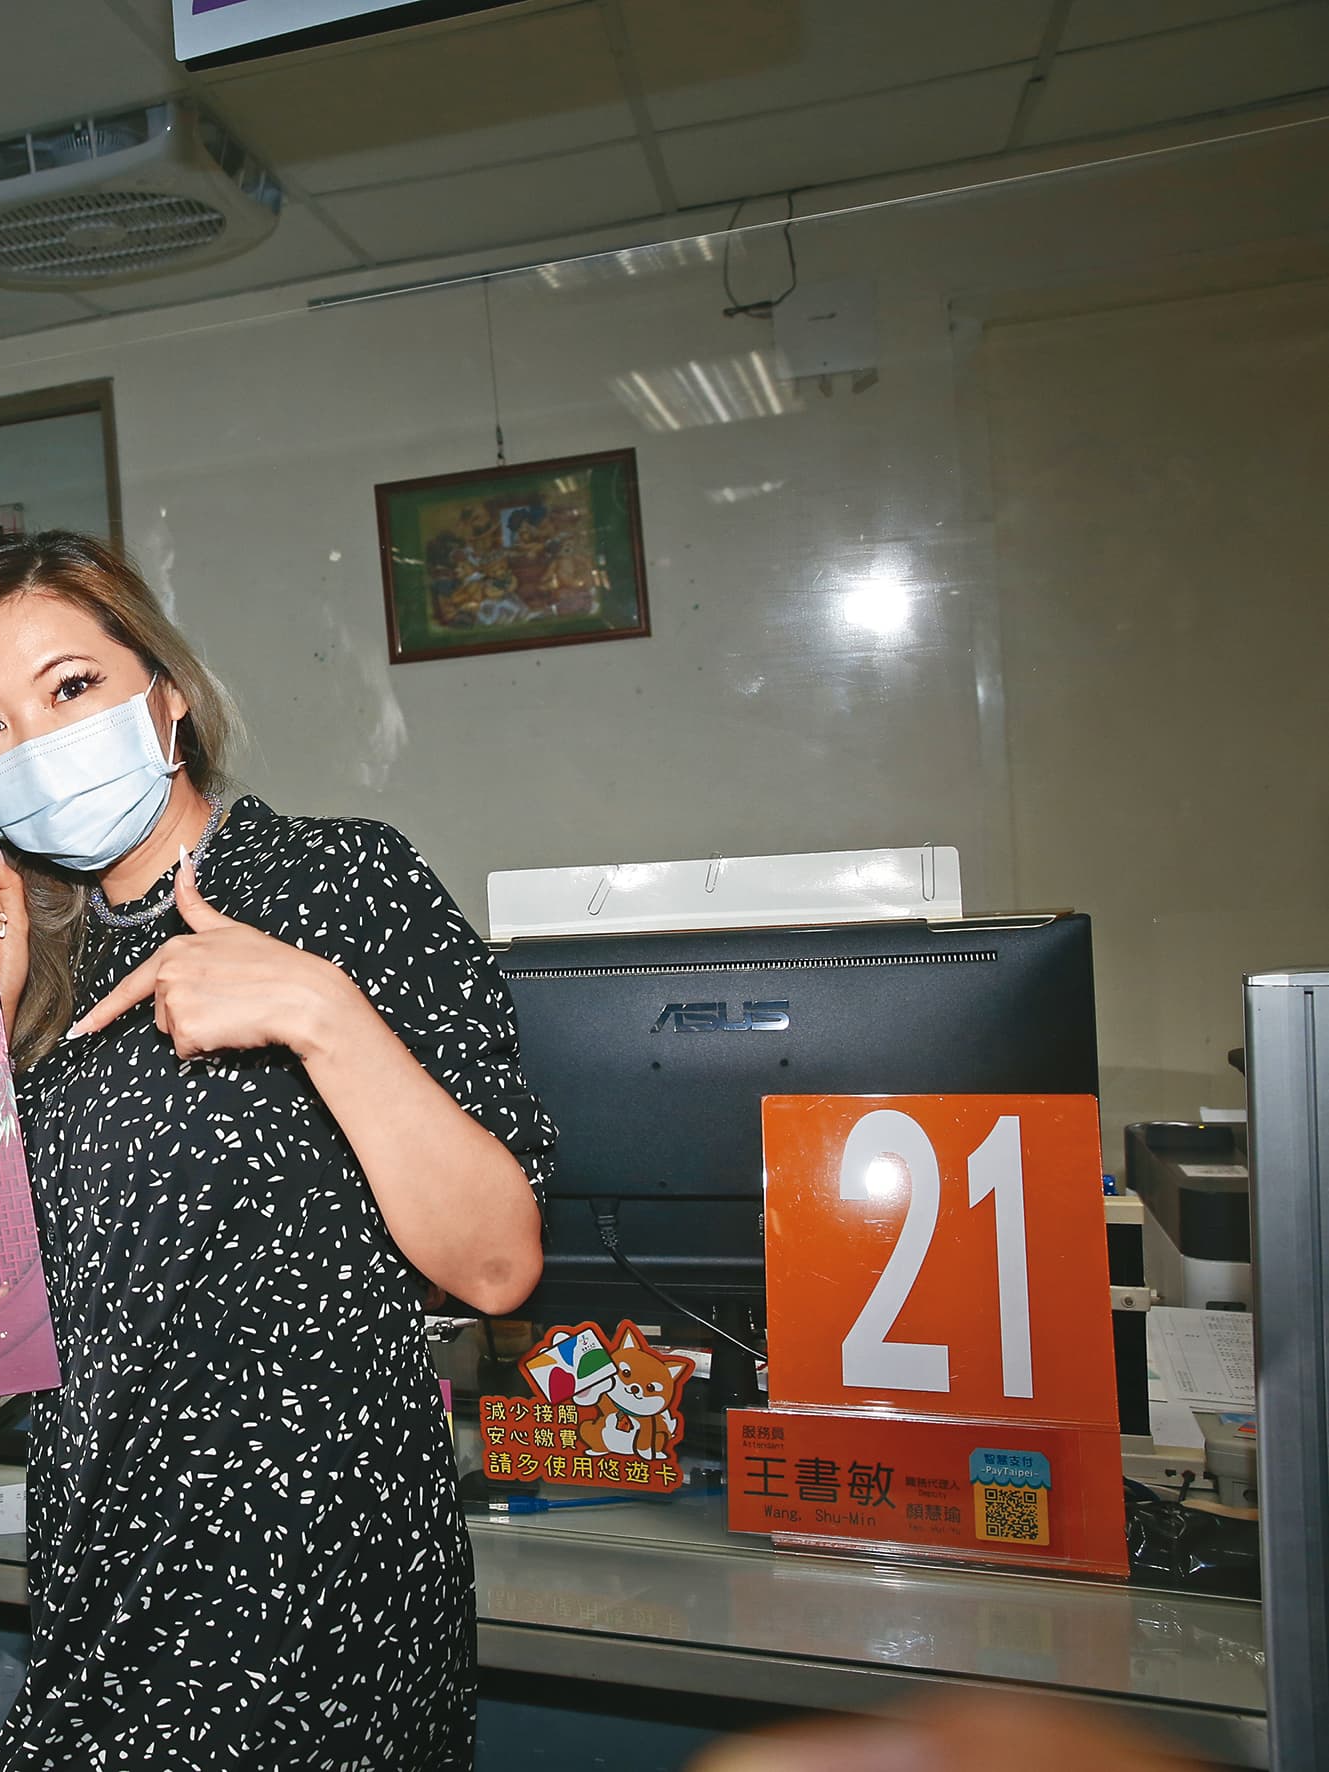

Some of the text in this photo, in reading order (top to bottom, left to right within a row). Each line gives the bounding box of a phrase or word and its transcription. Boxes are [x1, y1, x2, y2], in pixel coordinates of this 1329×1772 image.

[648, 1000, 790, 1033] ASUS
[839, 1108, 1034, 1400] 21
[485, 1401, 578, 1425] 減少接觸
[486, 1426, 577, 1450] 安心繳費
[742, 1425, 784, 1440] 服務員
[488, 1451, 678, 1487] 請多使用悠遊卡
[983, 1453, 1033, 1467] 智慧支付
[743, 1456, 896, 1509] 王書敏
[815, 1508, 877, 1527] Shu-Min
